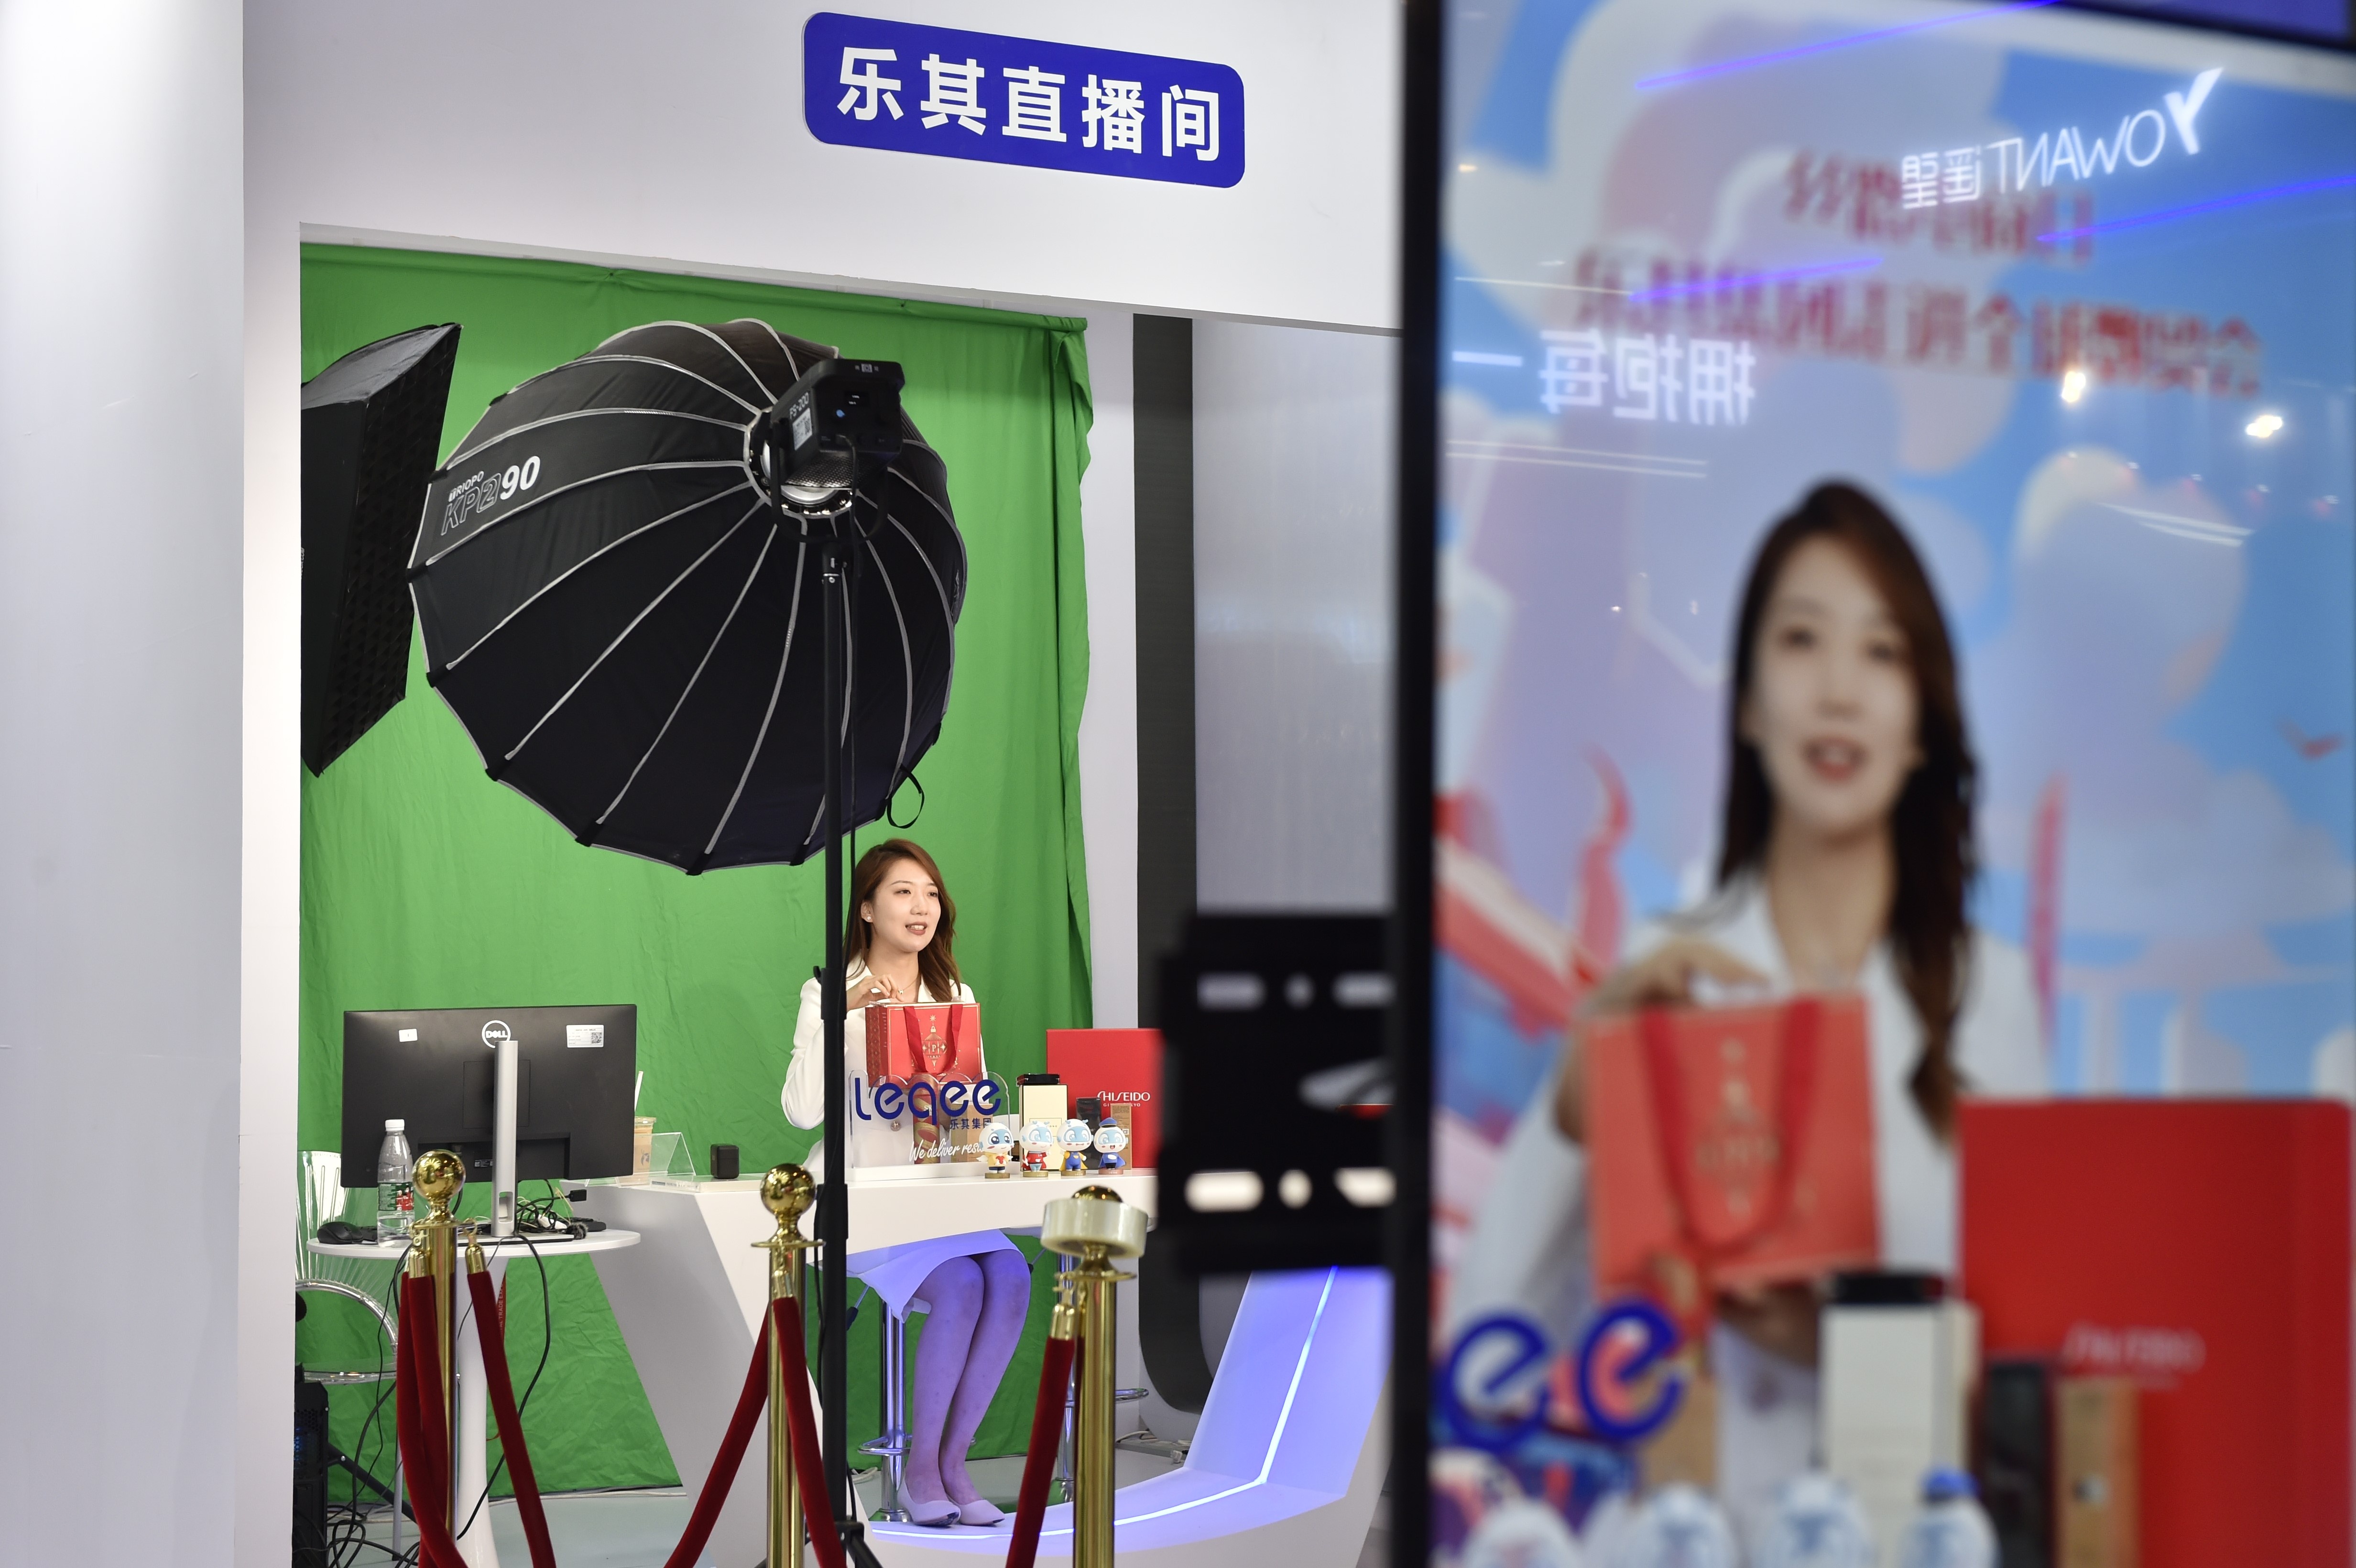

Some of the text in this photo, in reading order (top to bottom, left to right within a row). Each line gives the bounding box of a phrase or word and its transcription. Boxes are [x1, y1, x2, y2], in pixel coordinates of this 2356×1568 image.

[837, 46, 1219, 162] 乐其直播间
[485, 1030, 508, 1038] DELL
[909, 1138, 983, 1162] We deliver resu
